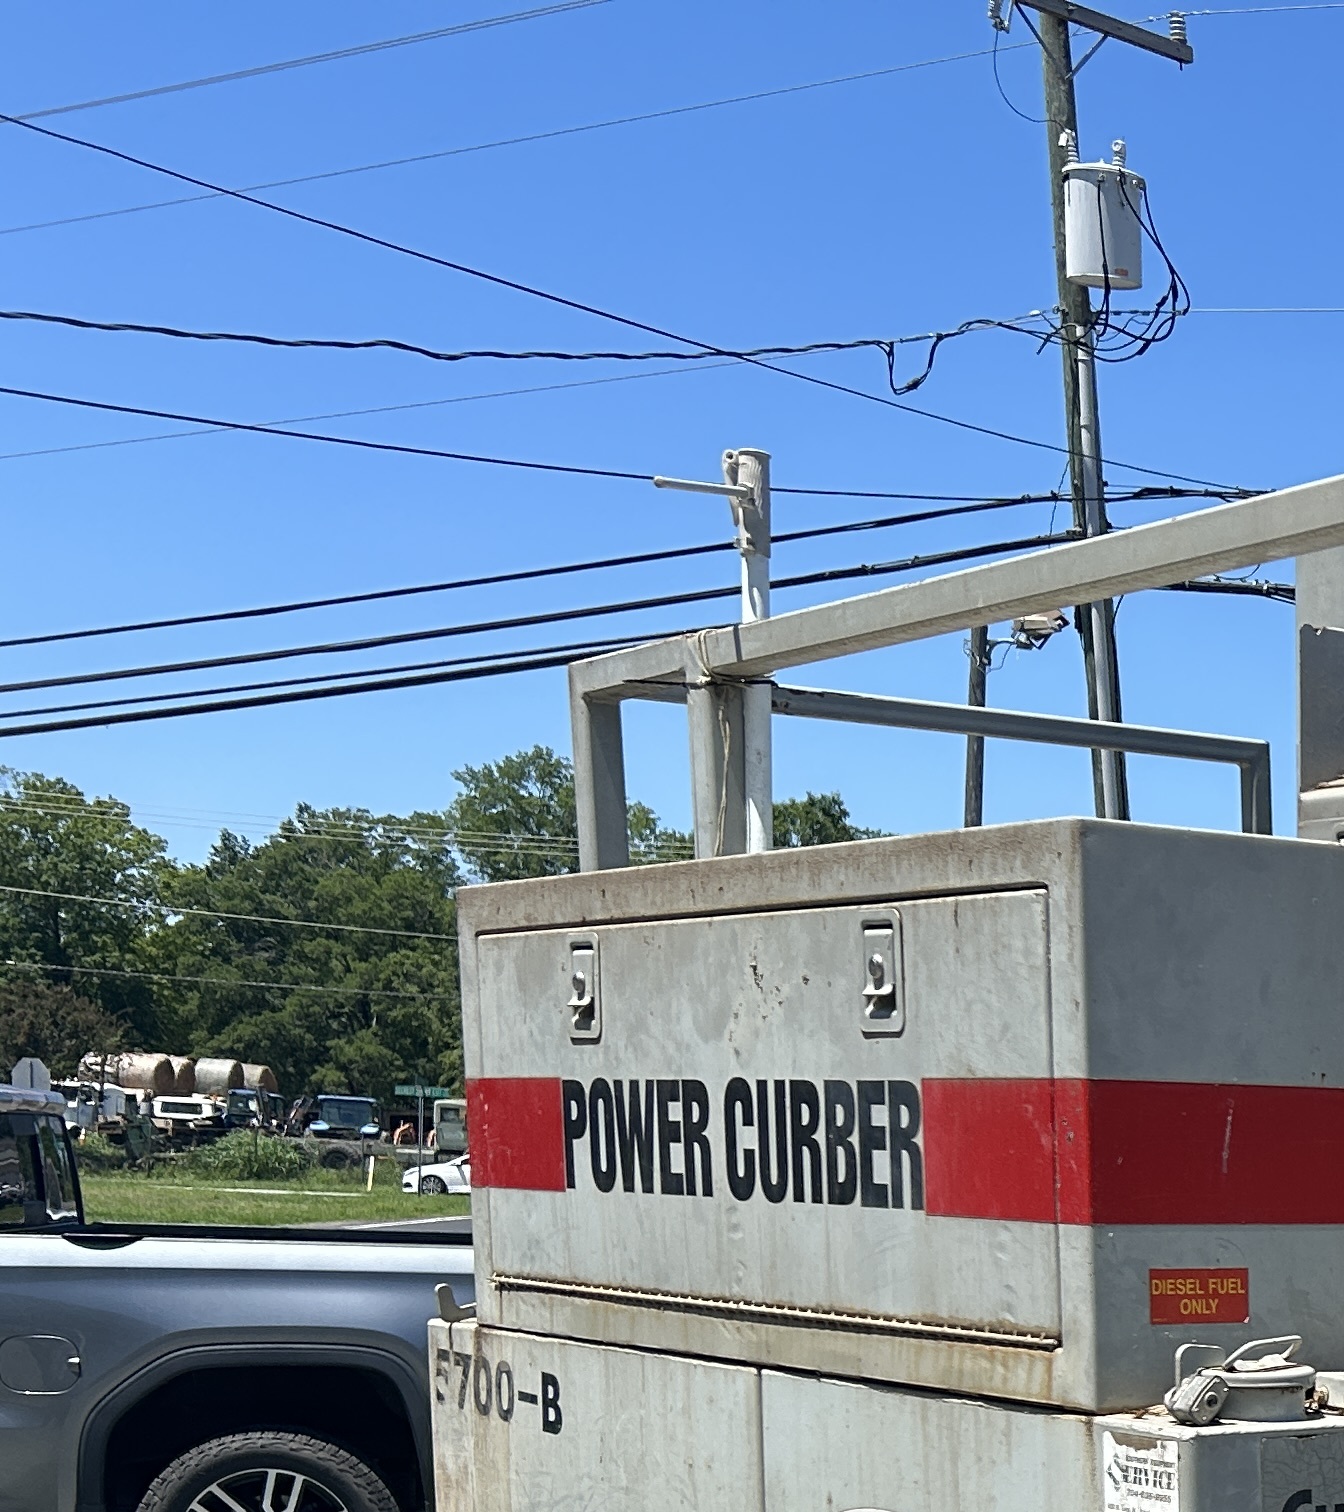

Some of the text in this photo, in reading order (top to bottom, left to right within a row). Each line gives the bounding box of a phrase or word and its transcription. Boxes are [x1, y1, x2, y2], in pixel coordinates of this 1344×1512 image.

[562, 1076, 925, 1211] POWER CURBER
[1151, 1277, 1246, 1295] DIESEL FUEL
[1180, 1298, 1219, 1315] ONLY
[436, 1347, 563, 1435] 5700-B
